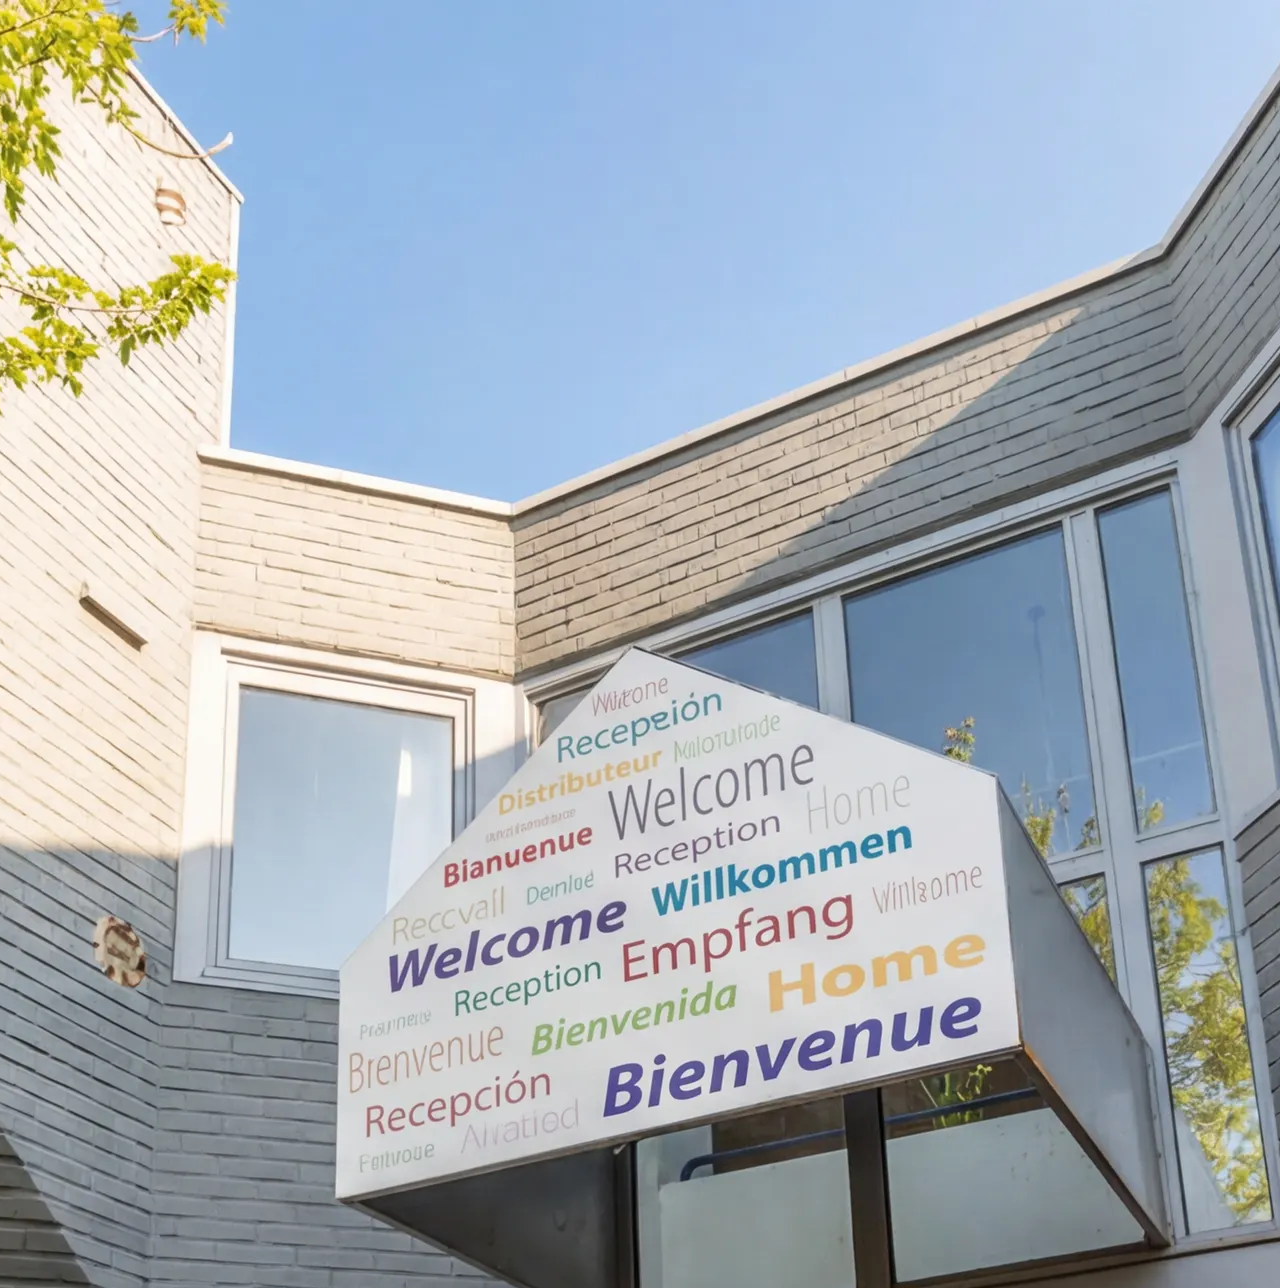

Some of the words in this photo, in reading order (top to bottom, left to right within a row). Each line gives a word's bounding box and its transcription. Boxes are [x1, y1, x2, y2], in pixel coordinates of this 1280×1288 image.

[498, 751, 662, 815] Distributeur
[608, 743, 815, 841] Welcome
[807, 775, 910, 834] Home
[614, 811, 781, 879] Reception
[651, 825, 913, 918] Willkommen
[387, 900, 626, 993] Welcome
[622, 894, 852, 983] Empfang
[768, 933, 985, 1013] Home
[454, 958, 601, 1018] Reception
[532, 981, 737, 1056] Bienvenida
[603, 996, 982, 1118] Bienvenue
[366, 1070, 550, 1138] Recepción
